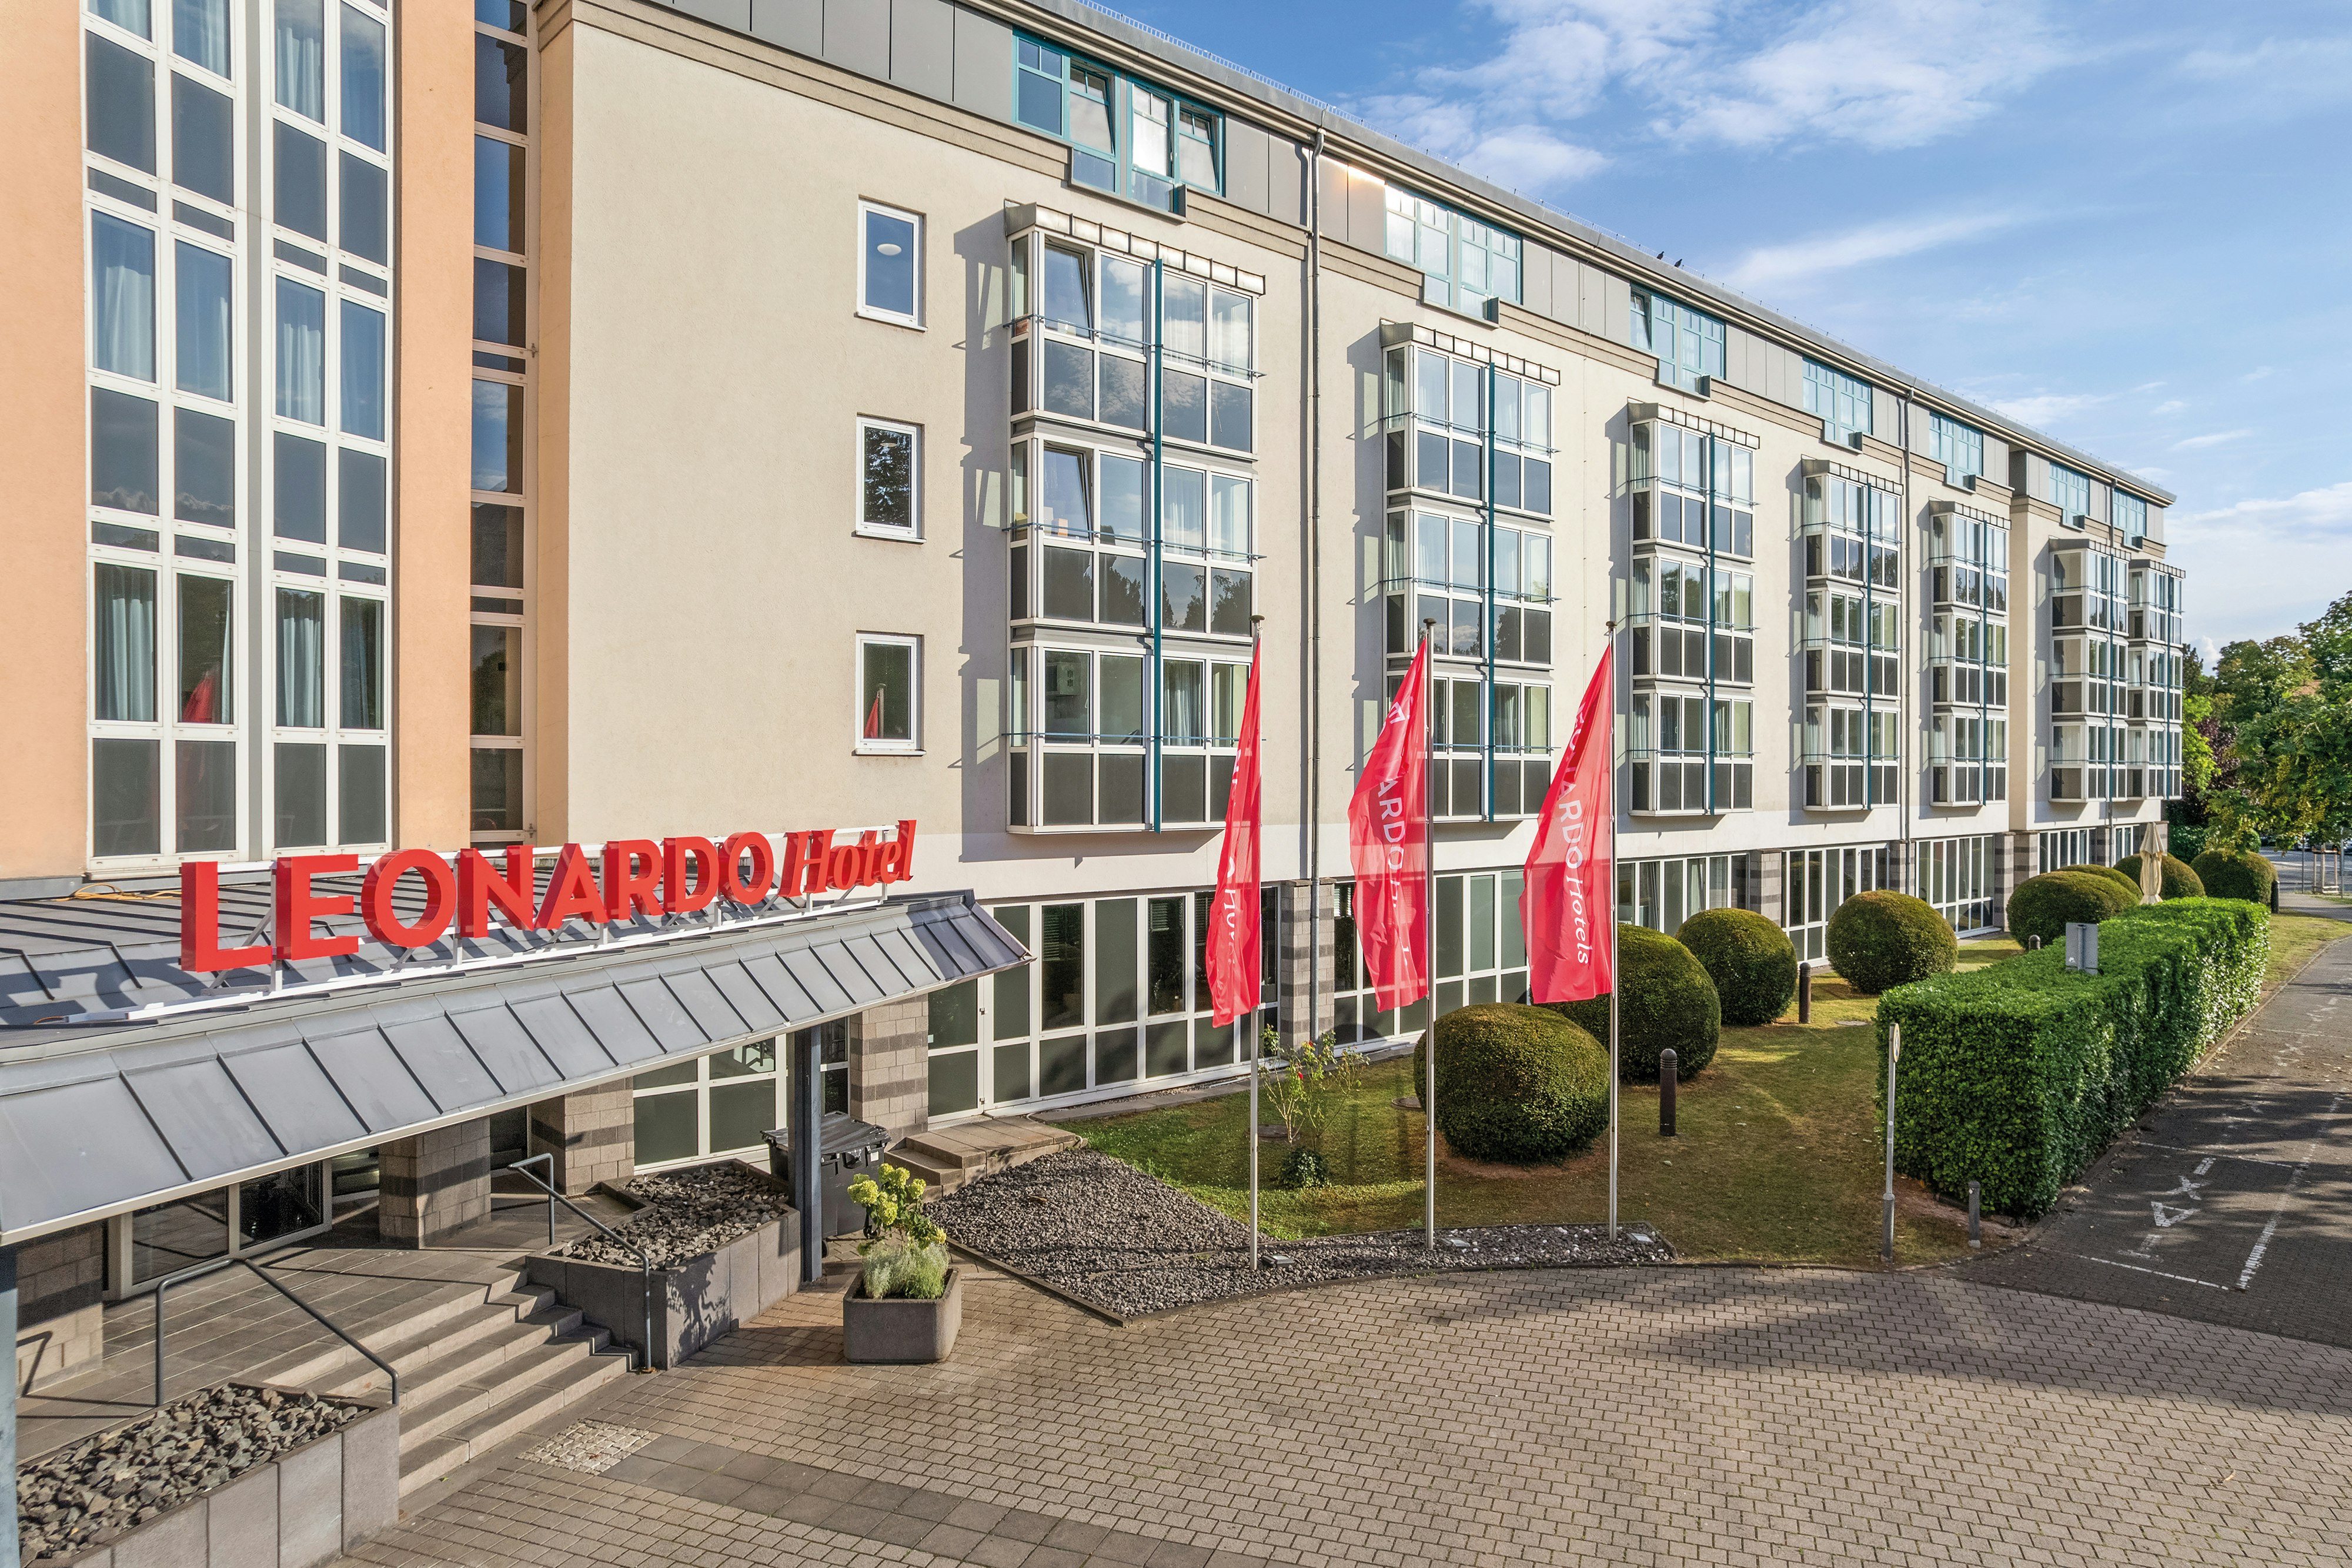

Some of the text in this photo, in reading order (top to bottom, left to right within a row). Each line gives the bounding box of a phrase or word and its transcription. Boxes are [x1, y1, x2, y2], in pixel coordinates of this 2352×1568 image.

[181, 819, 917, 973] LEONARDO Hotel
[1566, 875, 1593, 964] Hotels
